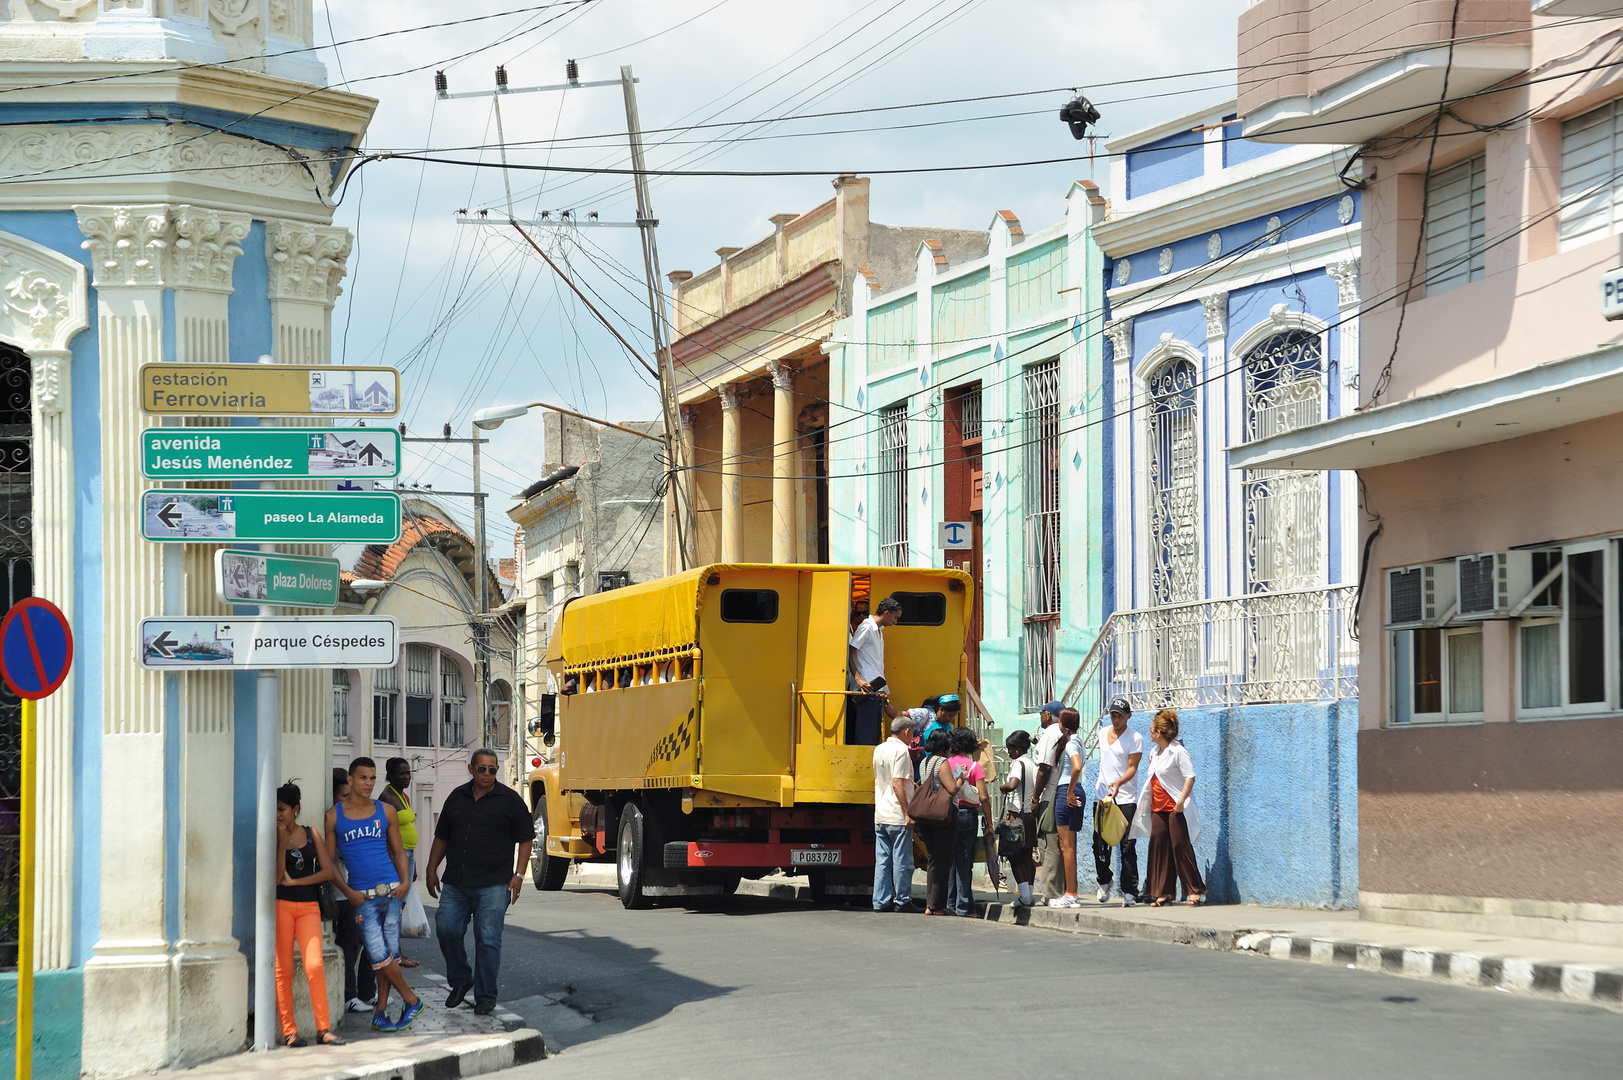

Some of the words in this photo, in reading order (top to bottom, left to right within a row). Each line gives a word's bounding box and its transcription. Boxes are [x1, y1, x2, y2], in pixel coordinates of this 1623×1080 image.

[152, 371, 228, 386] estación
[152, 390, 266, 408] Ferroviaria
[151, 436, 221, 450] avenida
[151, 455, 203, 470] Jesús
[207, 455, 293, 469] Menéndez
[264, 513, 304, 526] paseo
[308, 512, 324, 523] La
[326, 512, 384, 524] Alameda
[273, 571, 298, 590] plaza
[299, 574, 333, 591] Dolores
[254, 638, 307, 650] parque
[312, 634, 386, 650] Céspedes
[344, 826, 382, 842] ITALIA
